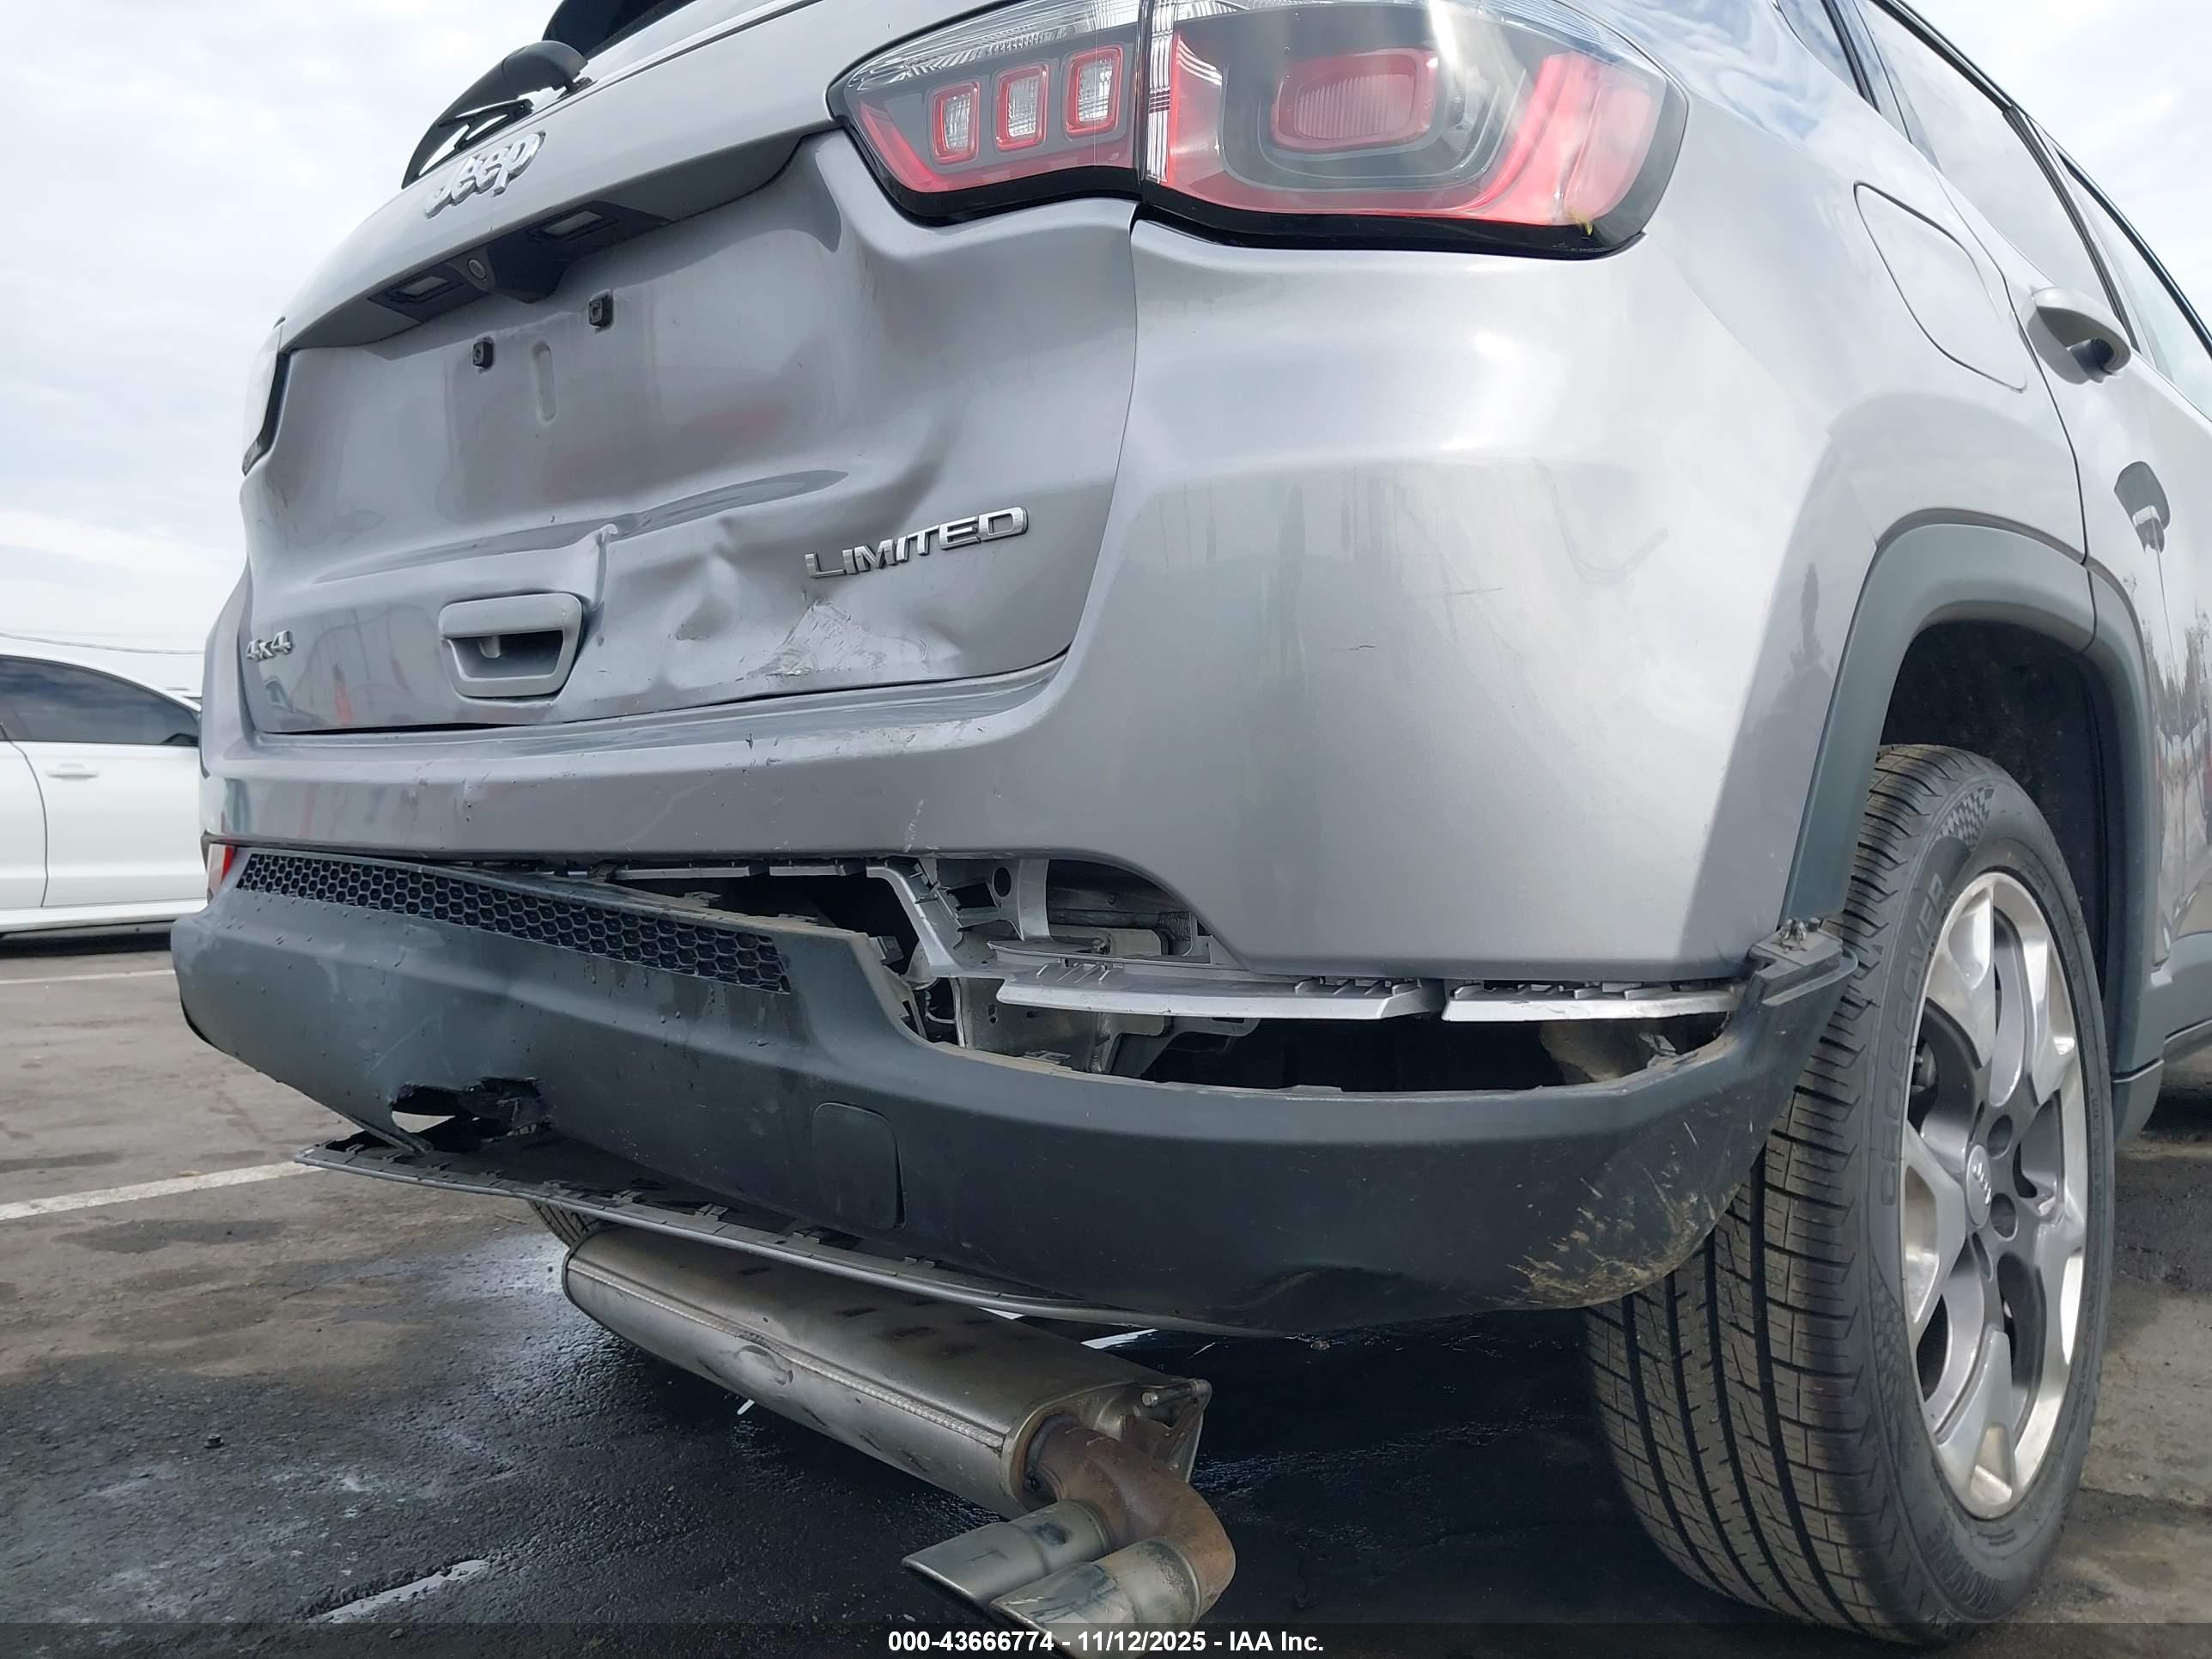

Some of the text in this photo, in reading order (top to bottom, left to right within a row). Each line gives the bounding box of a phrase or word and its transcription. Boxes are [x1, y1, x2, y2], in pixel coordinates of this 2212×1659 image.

[422, 131, 547, 220] Jeep
[805, 506, 1029, 579] LIMITED
[246, 630, 294, 662] 4x4
[1881, 872, 1945, 1206] CROSSOVER
